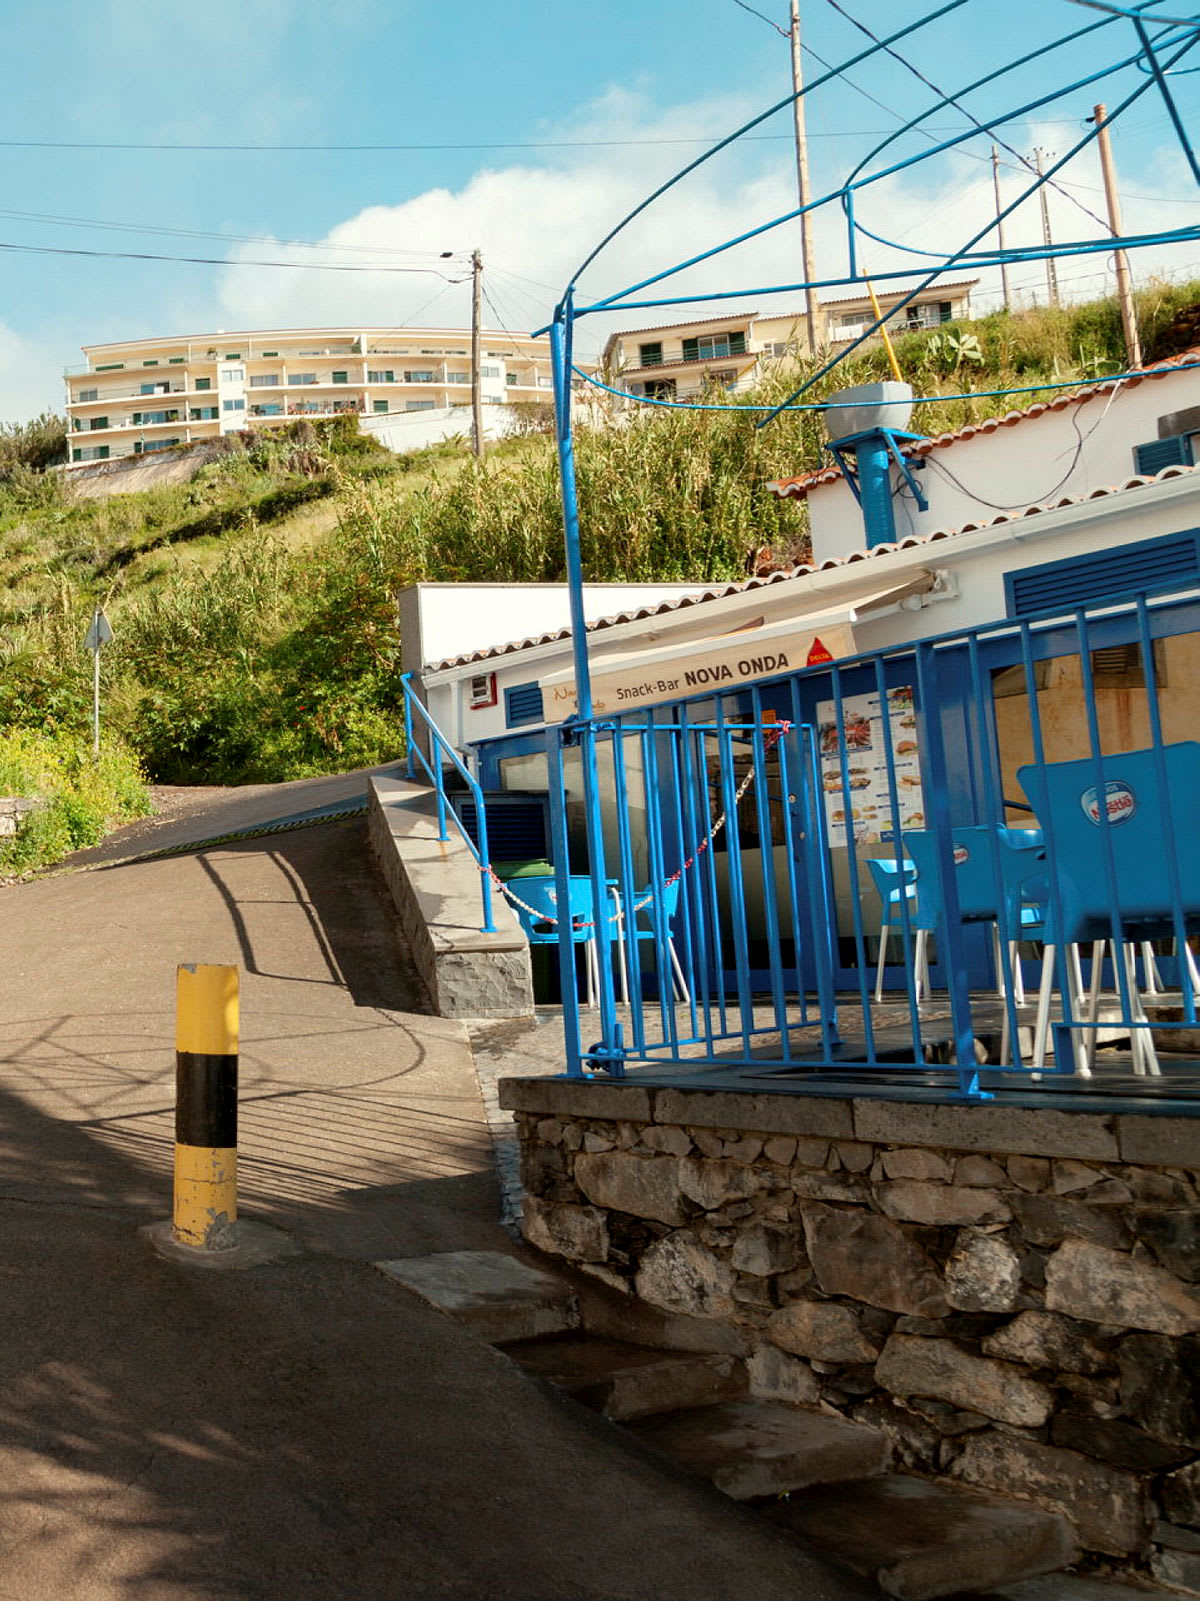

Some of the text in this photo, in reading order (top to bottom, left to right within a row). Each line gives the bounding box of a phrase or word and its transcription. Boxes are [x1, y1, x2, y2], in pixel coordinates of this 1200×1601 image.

[616, 652, 789, 700] Snack-Bar NOVA ONDA
